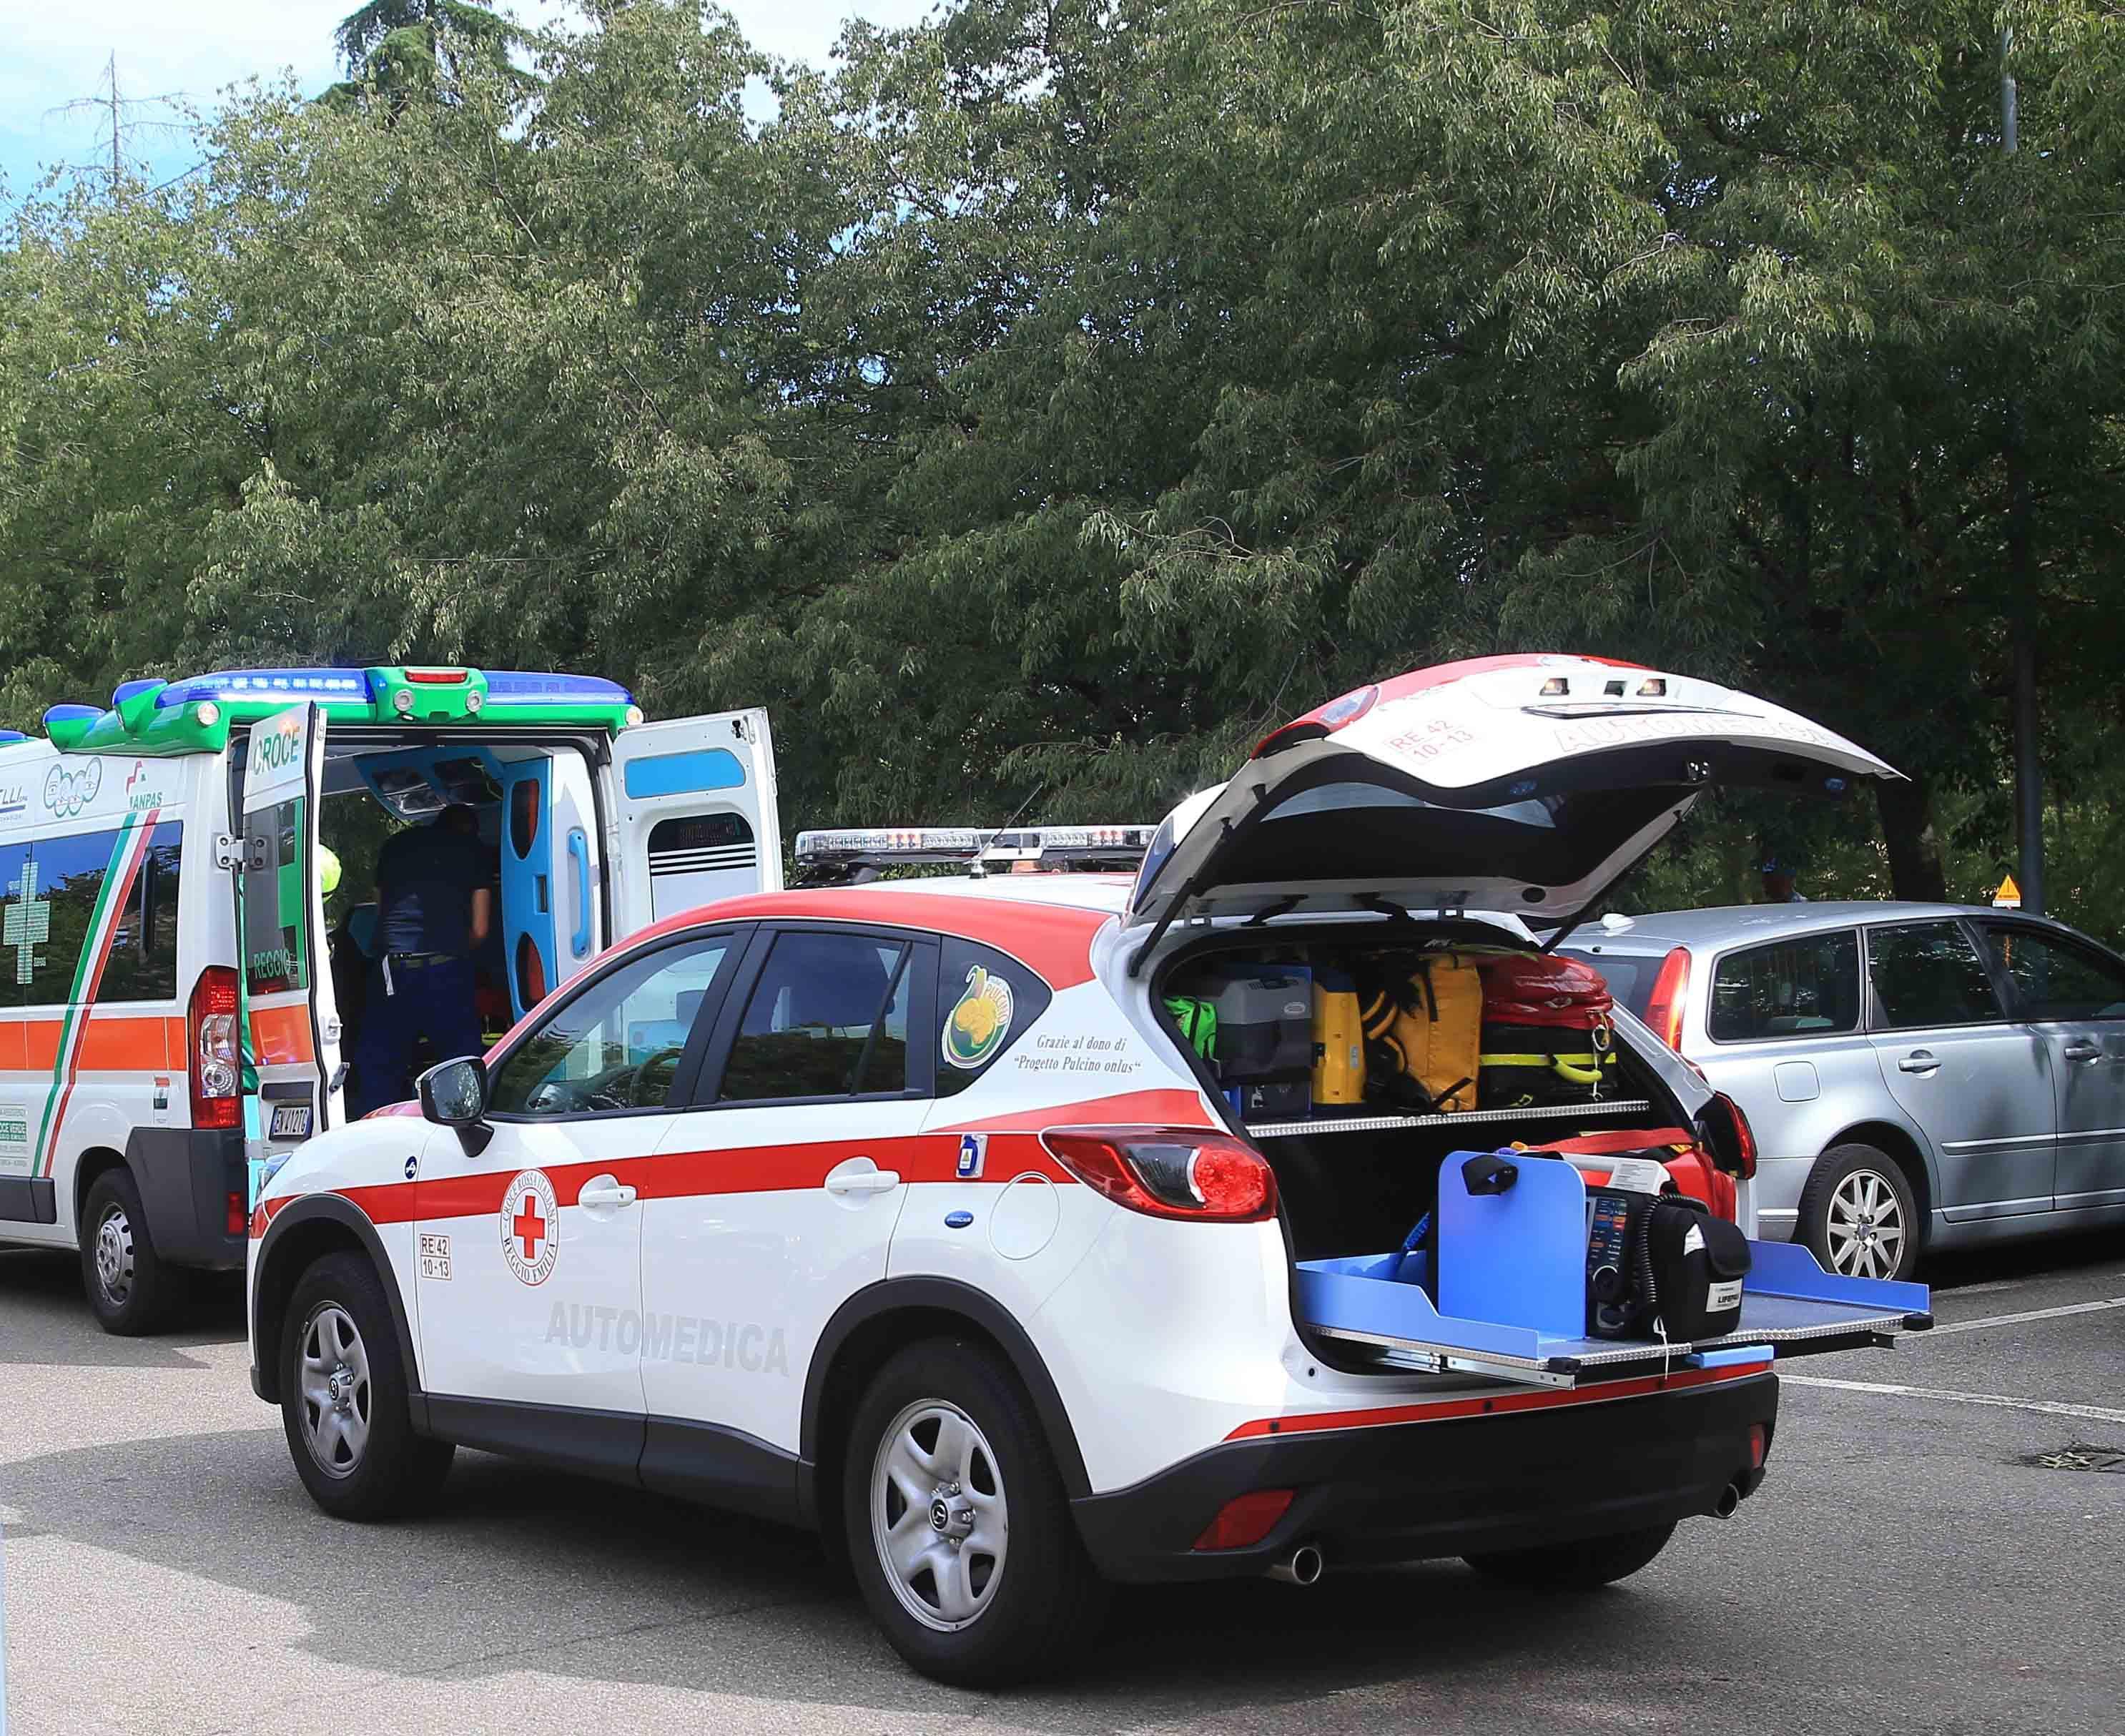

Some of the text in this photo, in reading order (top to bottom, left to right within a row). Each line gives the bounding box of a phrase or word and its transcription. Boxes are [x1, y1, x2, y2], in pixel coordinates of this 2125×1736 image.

[253, 726, 300, 776] CROCE
[1389, 731, 1425, 749] RE
[254, 949, 290, 979] REGGIO
[1037, 1035, 1128, 1052] Grazie al dono di
[1062, 1056, 1100, 1071] Pulcino
[503, 1184, 518, 1222] CROCE
[422, 1237, 447, 1256] RE 42
[423, 1258, 449, 1277] 10-13
[503, 1237, 556, 1283] REGGIO EMILIA
[543, 1300, 789, 1378] AUTOMEDICA
